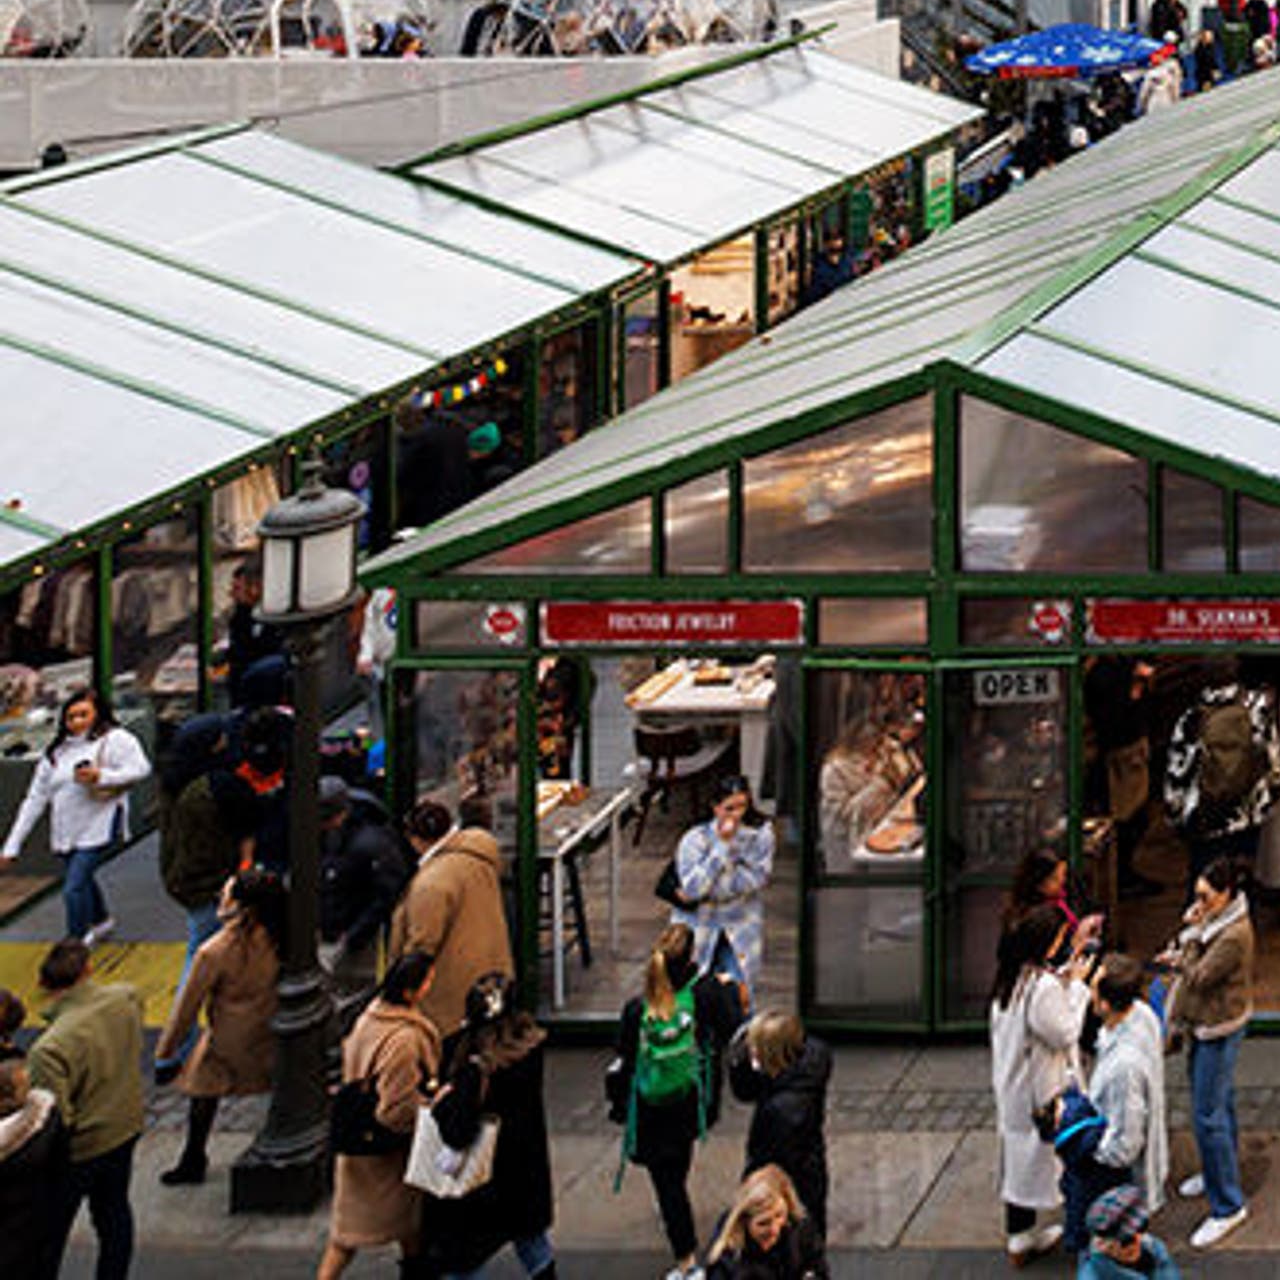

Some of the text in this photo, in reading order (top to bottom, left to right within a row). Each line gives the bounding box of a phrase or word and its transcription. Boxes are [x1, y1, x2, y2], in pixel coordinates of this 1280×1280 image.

[608, 612, 736, 630] FRICTION JEWELRY
[981, 673, 1049, 698] OPEN
